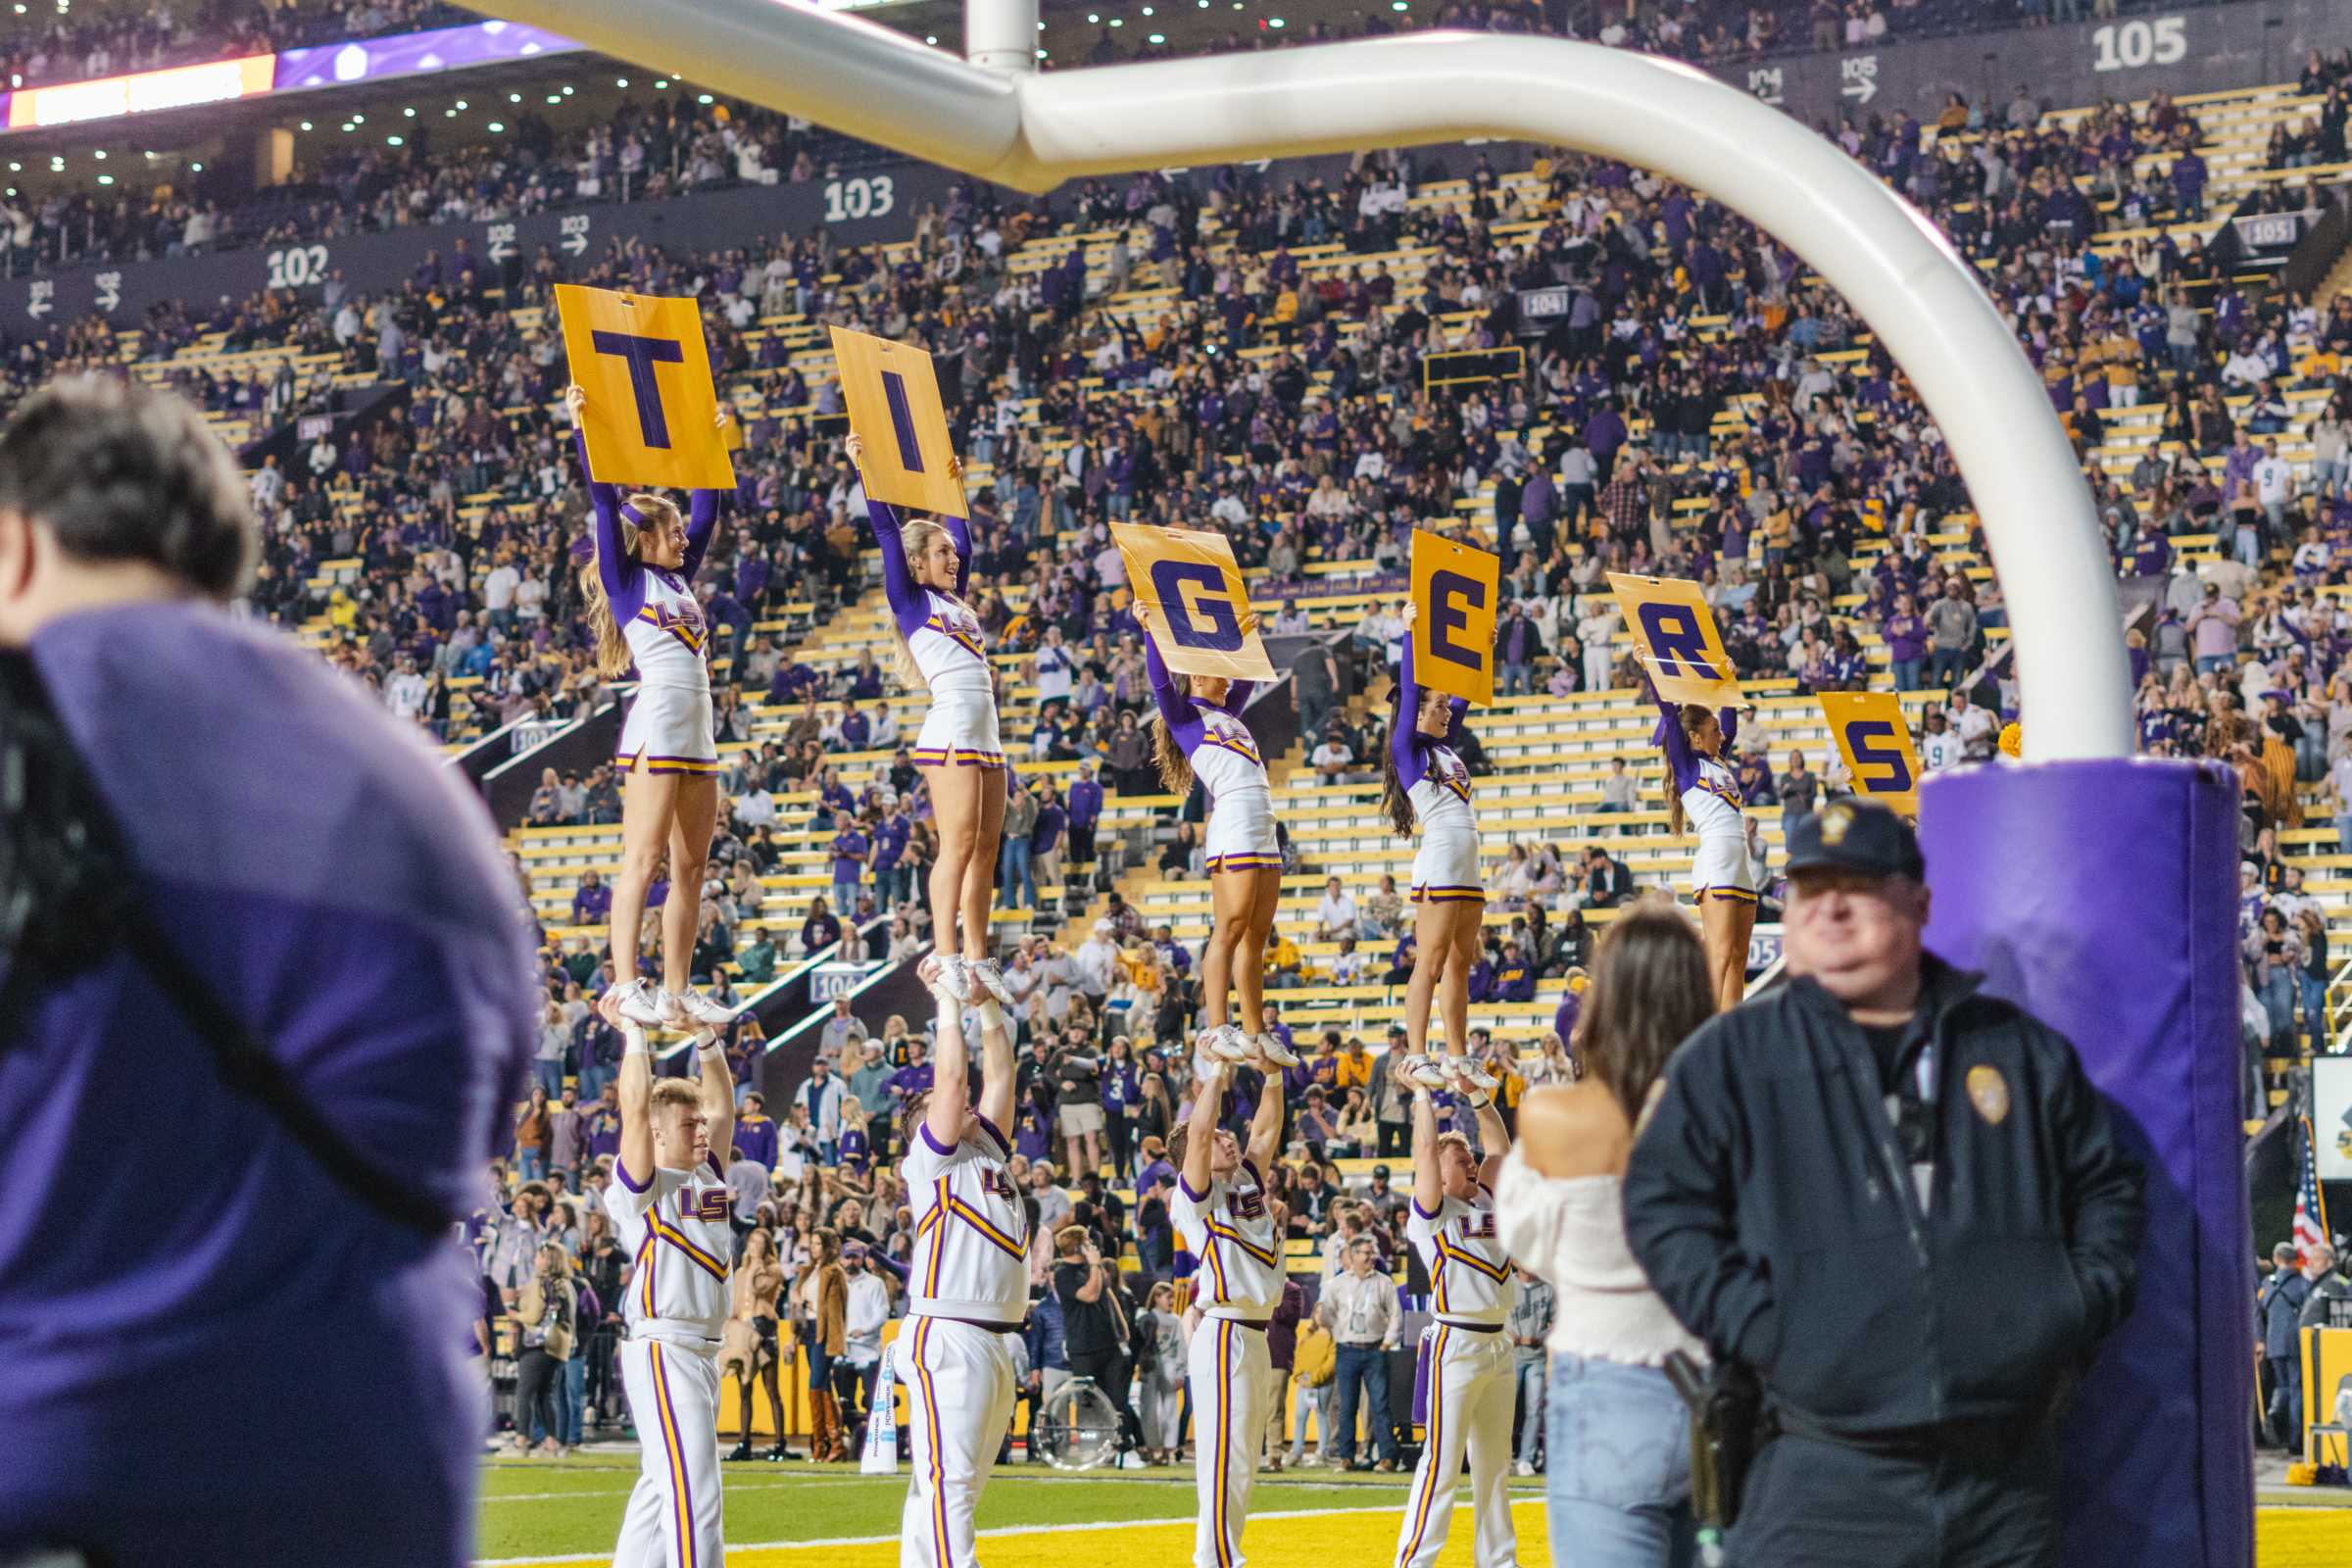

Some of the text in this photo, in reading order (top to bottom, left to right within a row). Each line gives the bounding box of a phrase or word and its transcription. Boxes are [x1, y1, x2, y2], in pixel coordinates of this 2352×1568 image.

[1841, 56, 1878, 79] 105
[2093, 16, 2186, 71] 105
[825, 176, 894, 222] 103
[2253, 220, 2287, 245] 105
[268, 245, 328, 288] 102
[593, 330, 683, 449] T
[881, 371, 924, 474] I
[1151, 560, 1244, 652] G
[1430, 569, 1486, 672] E
[1638, 602, 1724, 680] R
[1846, 721, 1911, 792] S
[1933, 746, 1942, 766] 9
[1109, 1077, 1124, 1101] 3
